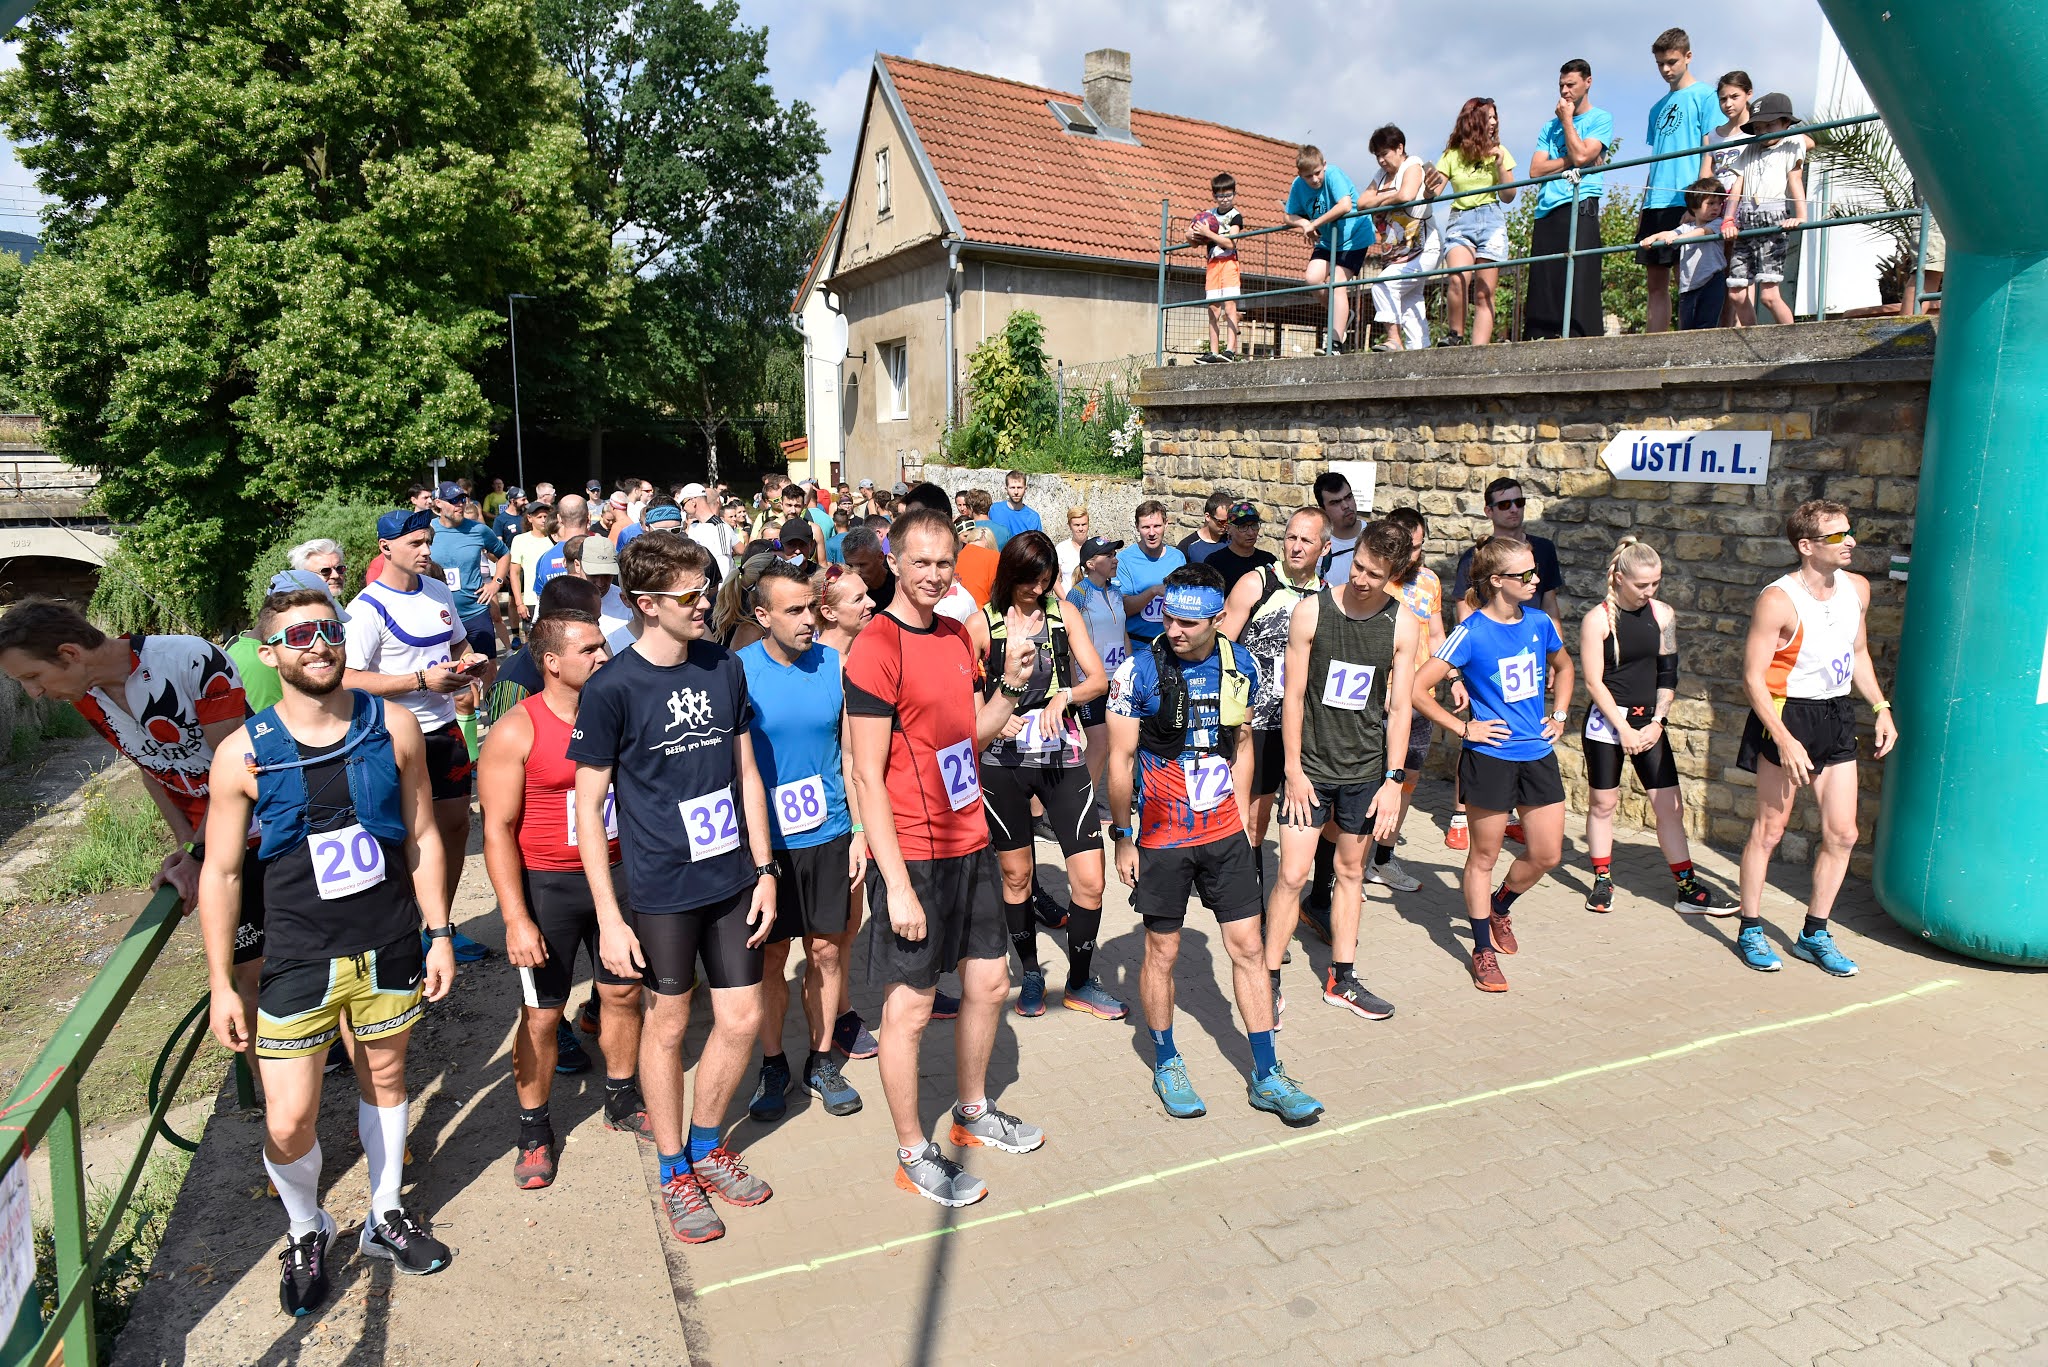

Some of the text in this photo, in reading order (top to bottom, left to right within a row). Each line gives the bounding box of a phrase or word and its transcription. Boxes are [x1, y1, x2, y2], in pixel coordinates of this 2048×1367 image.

[1631, 436, 1757, 474] ÚSTÍ n. L.
[1144, 599, 1164, 616] 87
[1105, 646, 1126, 666] 45
[1831, 652, 1851, 685] 82
[1332, 668, 1371, 700] 12
[1505, 660, 1534, 692] 51
[571, 728, 584, 740] 20
[688, 741, 700, 752] pro
[700, 735, 723, 747] hospic
[1021, 714, 1051, 743] 7
[944, 747, 977, 795] 23
[1189, 763, 1232, 801] 72
[781, 784, 820, 823] 88
[690, 798, 738, 846] 32
[316, 831, 380, 884] 20
